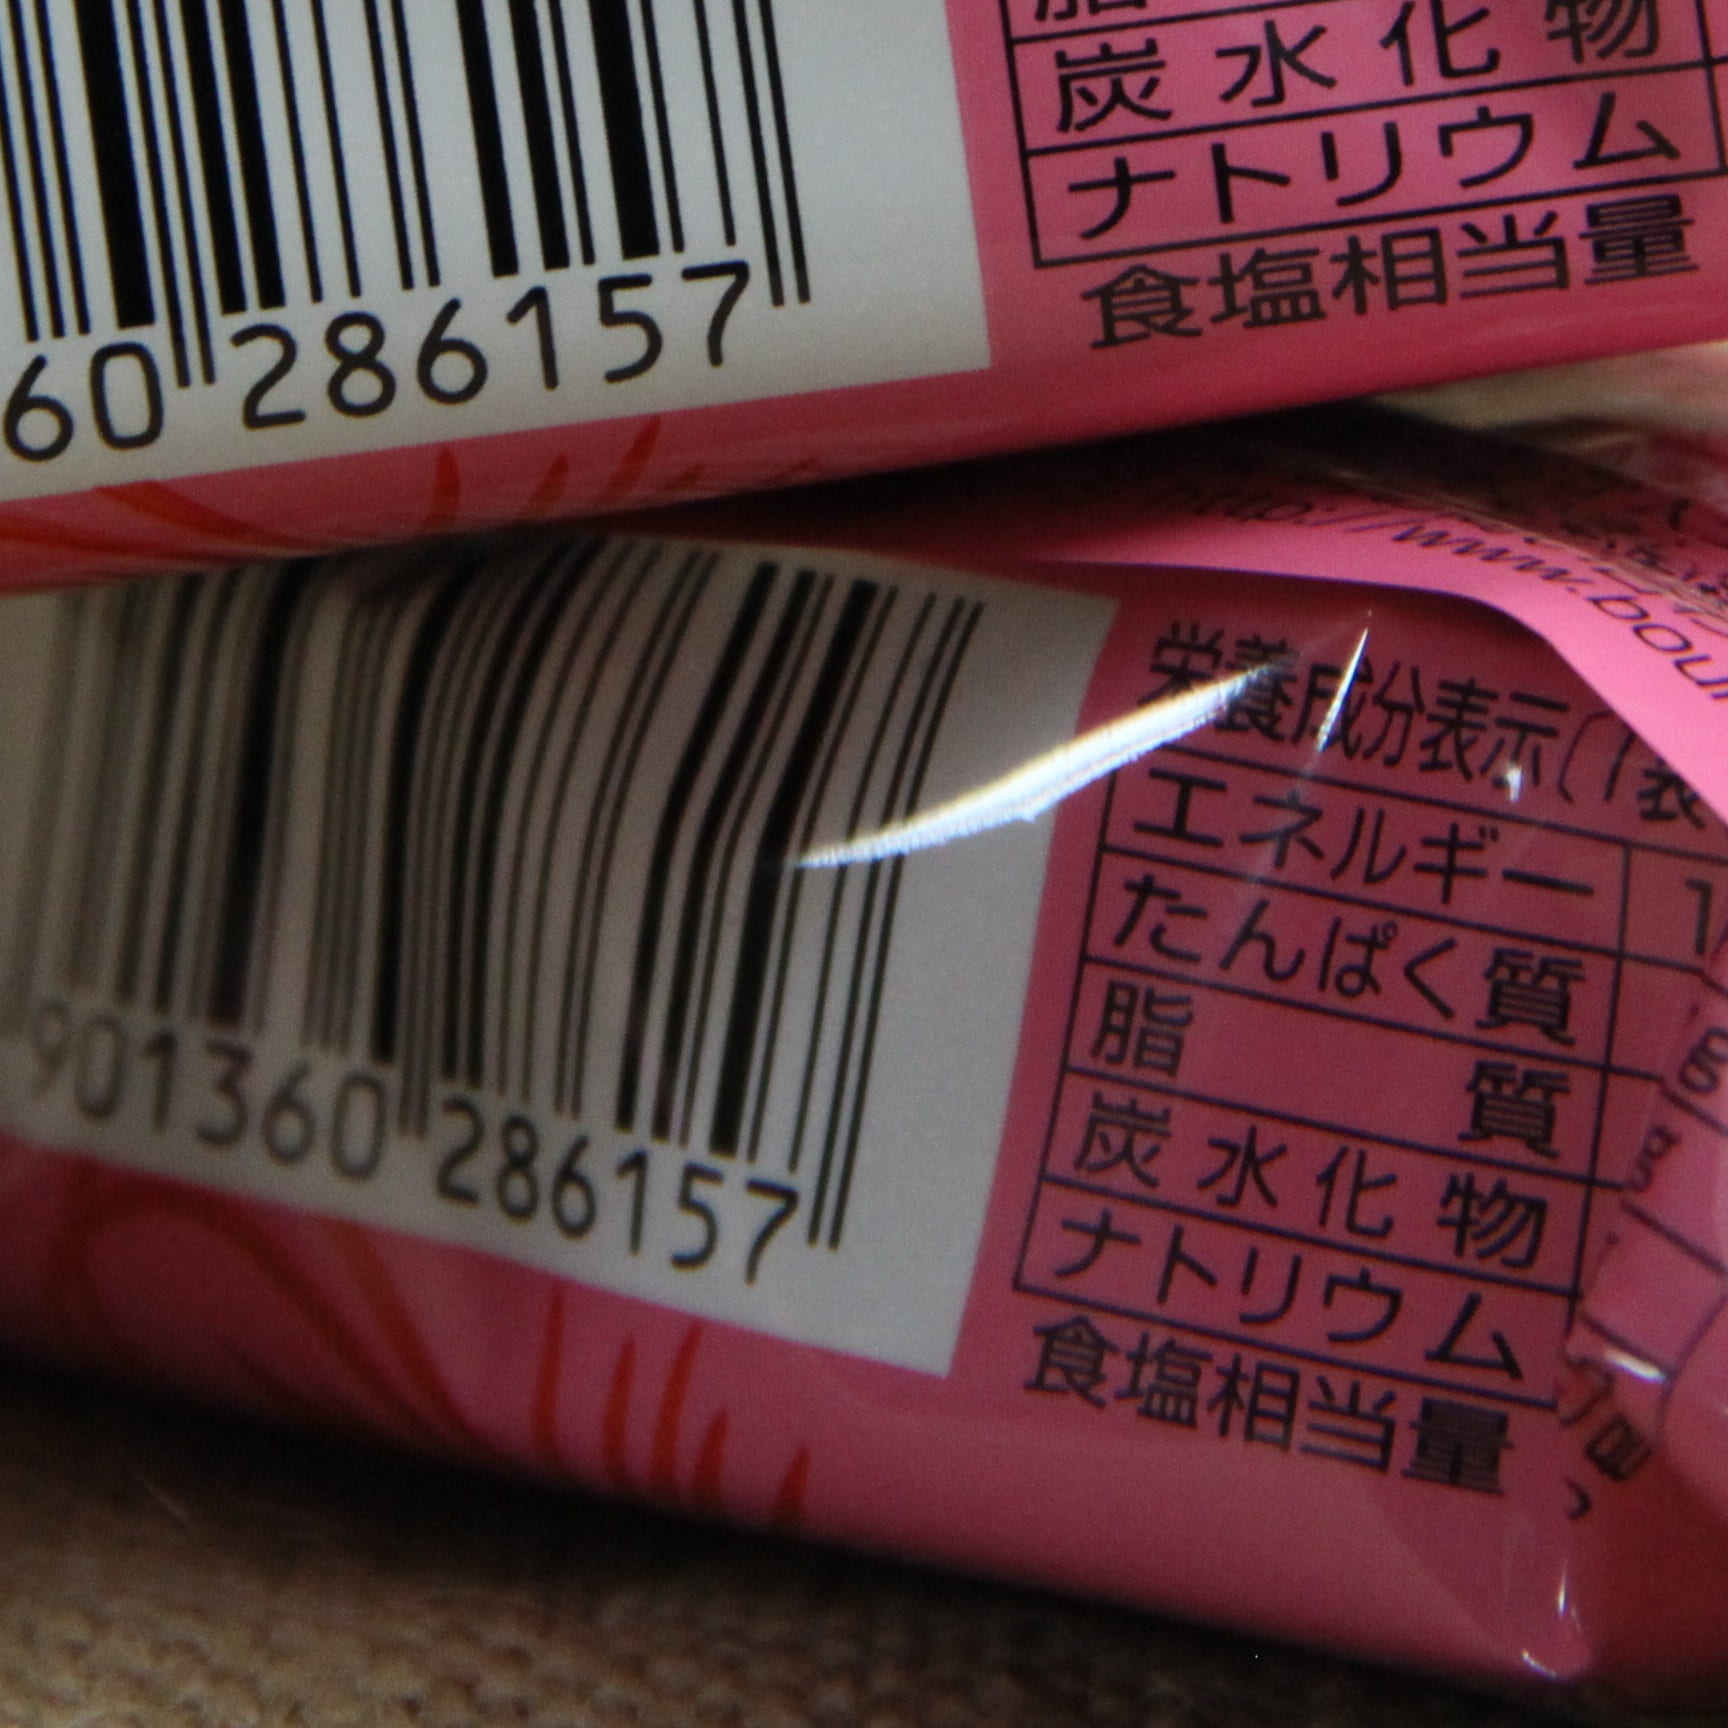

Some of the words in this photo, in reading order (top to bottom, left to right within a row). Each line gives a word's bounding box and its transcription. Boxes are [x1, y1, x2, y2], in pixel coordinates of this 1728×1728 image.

[1068, 91, 1684, 241] ナトリウム
[232, 259, 754, 430] 286157
[1088, 191, 1700, 350] 食塩相当量
[1133, 767, 1595, 906] エネルギー
[1108, 873, 1586, 1047] たんぱく質
[24, 998, 391, 1184] 901360
[434, 1096, 802, 1285] 286157
[1090, 980, 1193, 1078] 脂
[1459, 1058, 1572, 1162] 質
[1073, 1094, 1548, 1269] 炭水化物
[1052, 1206, 1526, 1381] ナトリウム
[1024, 1314, 1515, 1497] 食塩相当量
